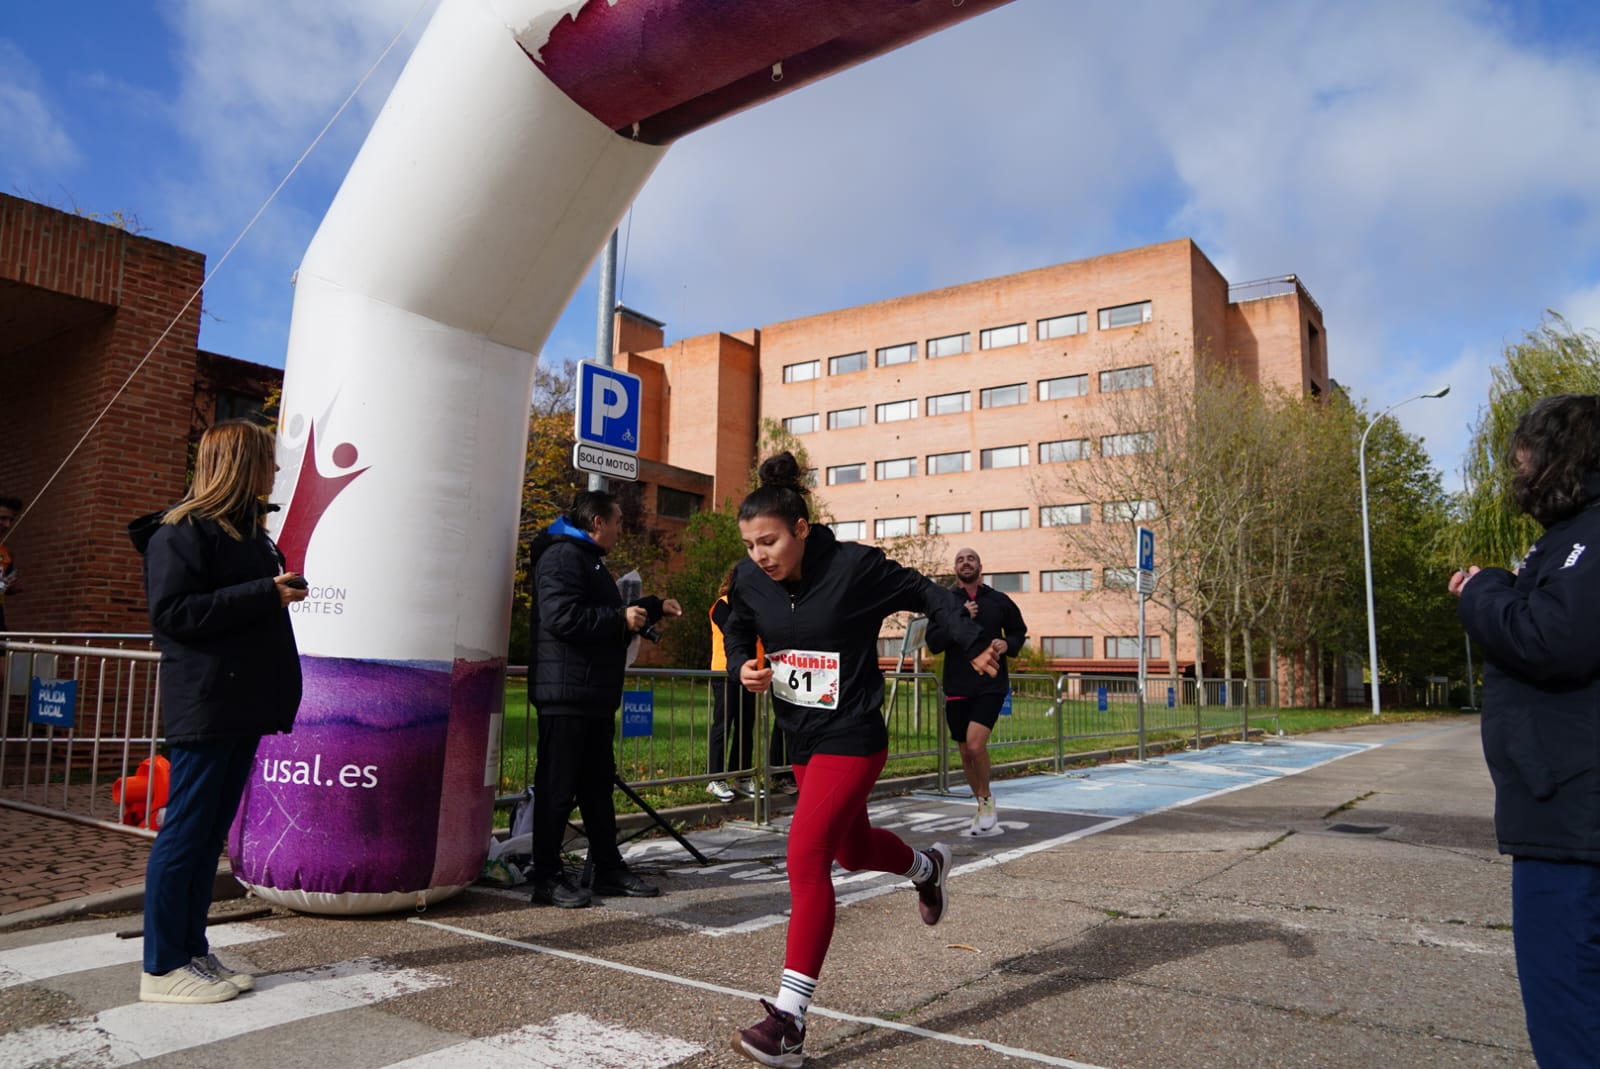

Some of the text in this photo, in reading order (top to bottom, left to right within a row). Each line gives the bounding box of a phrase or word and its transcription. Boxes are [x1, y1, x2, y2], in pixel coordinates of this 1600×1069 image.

[590, 373, 629, 437] P
[579, 451, 636, 473] SOLO MOTOS
[1142, 534, 1152, 565] P
[1559, 543, 1587, 570] Jom
[308, 585, 347, 600] CIÓN
[291, 601, 344, 615] ORTES
[788, 670, 812, 692] 61
[38, 704, 63, 718] LOCAL
[263, 754, 379, 788] usal.es
